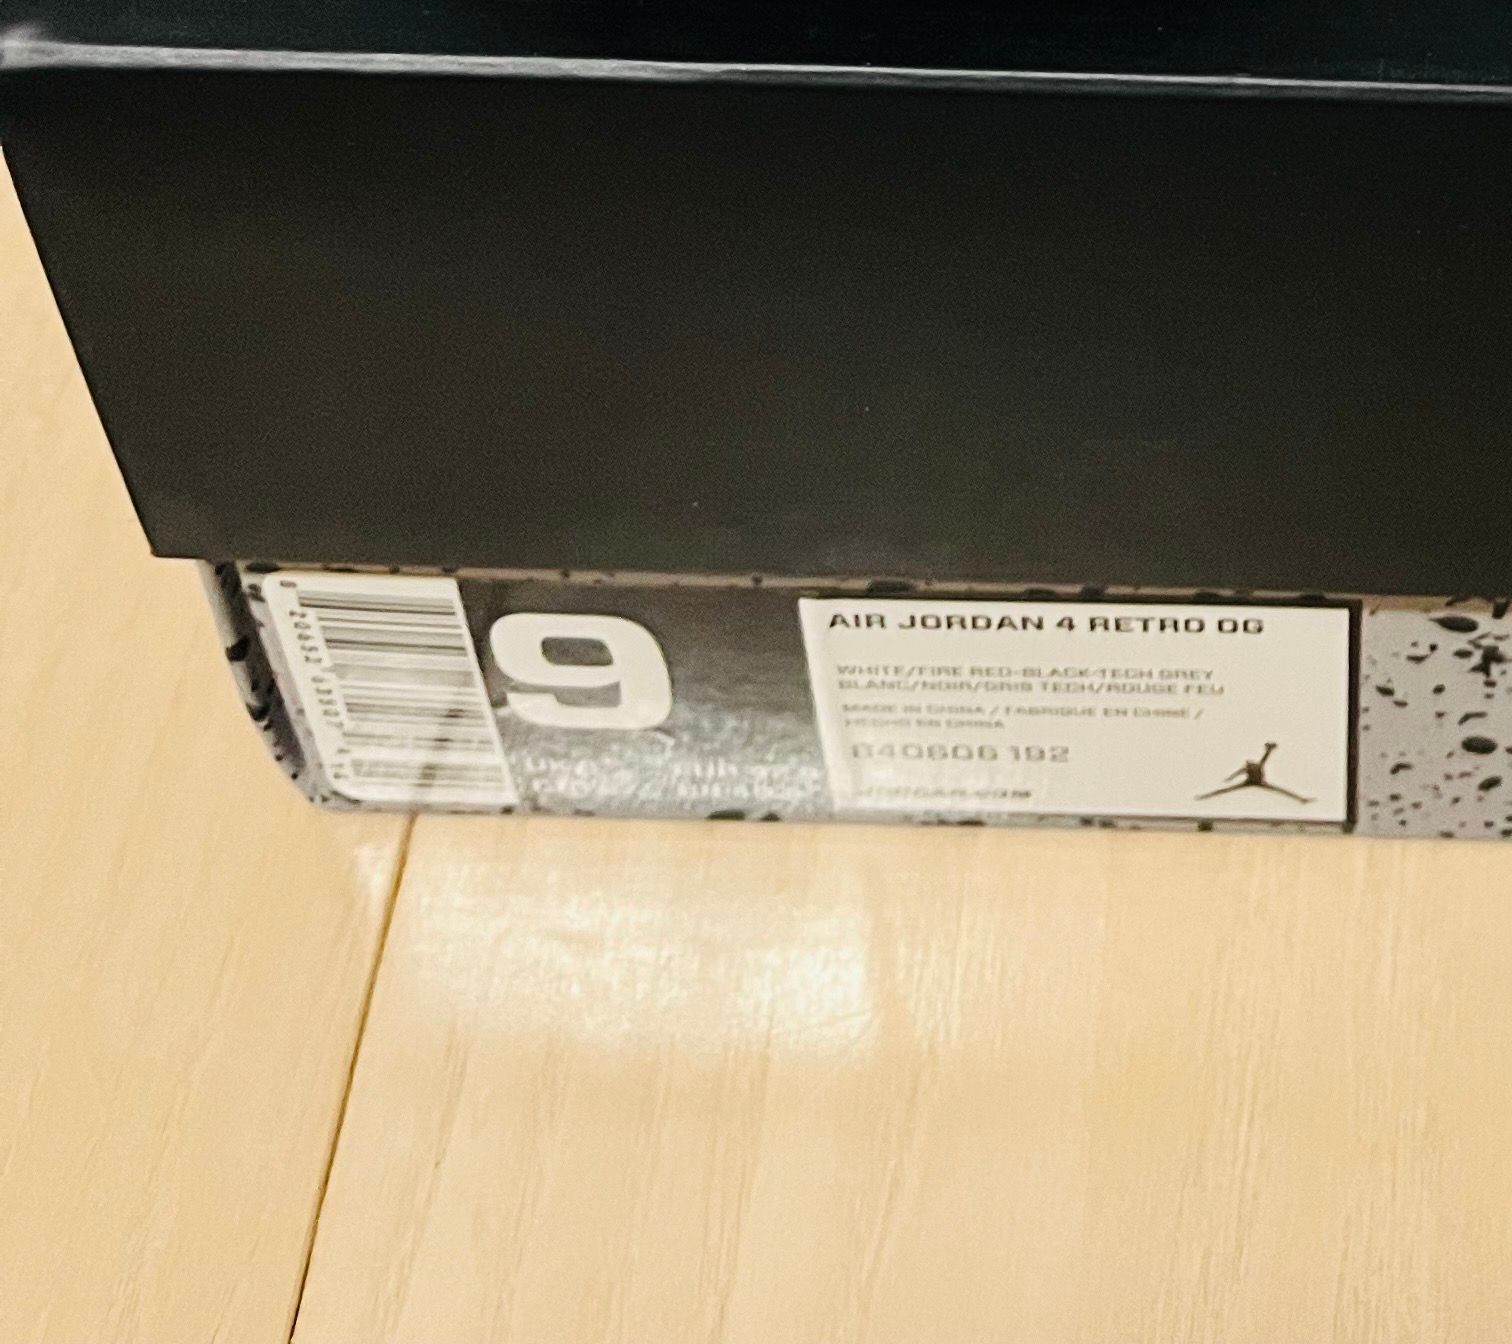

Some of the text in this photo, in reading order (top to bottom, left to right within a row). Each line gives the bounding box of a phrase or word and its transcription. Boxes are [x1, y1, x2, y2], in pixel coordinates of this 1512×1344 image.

[828, 613, 1265, 635] AIR JORDAN 4 RETRO OG
[489, 612, 673, 730] 9
